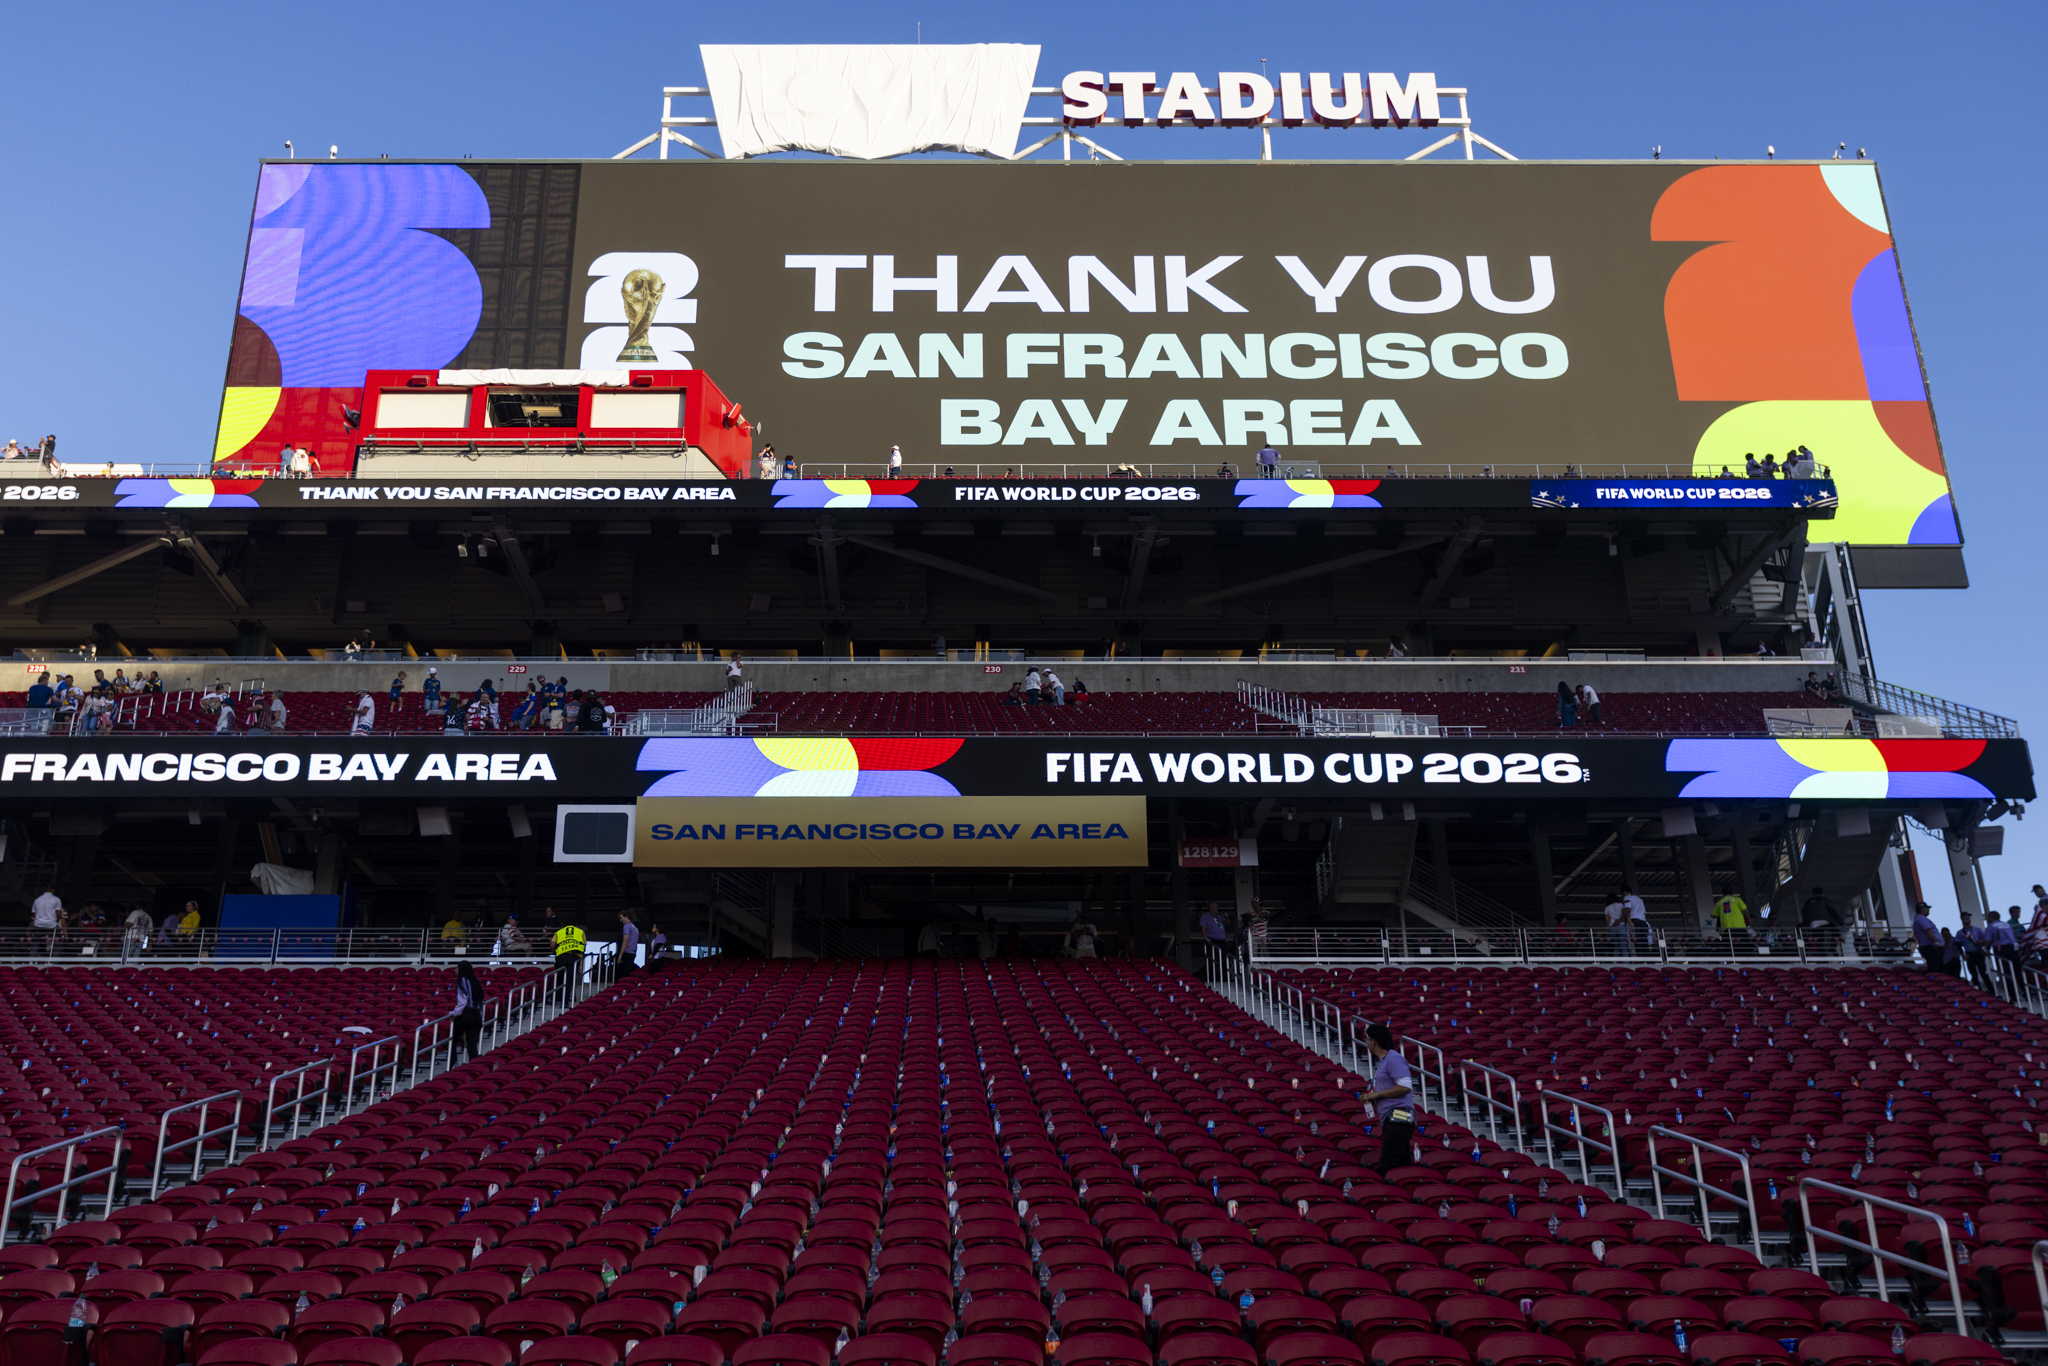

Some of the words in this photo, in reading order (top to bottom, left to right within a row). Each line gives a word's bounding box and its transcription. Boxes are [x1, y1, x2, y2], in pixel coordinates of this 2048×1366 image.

[1061, 70, 1441, 127] STADIUM
[784, 254, 1249, 313] THANK
[1275, 254, 1556, 315] YOU
[781, 332, 984, 379] SAN
[1006, 332, 1569, 380] FRANCISCO
[940, 398, 1128, 446] BAY
[1149, 399, 1423, 446] AREA
[3, 485, 77, 500] 2026
[298, 486, 380, 500] THANK
[382, 486, 432, 500] YOU
[433, 486, 484, 500] SAN
[485, 486, 621, 501] FRANCISCO
[623, 487, 670, 500] BAY
[671, 487, 737, 500] AREA
[955, 486, 999, 501] FIFA
[1002, 486, 1077, 501] WORLD
[1080, 486, 1122, 501] CUP
[1125, 486, 1197, 501] 2026
[1595, 488, 1629, 499] FIFA
[1630, 488, 1685, 499] WORLD
[1686, 488, 1717, 499] CUP
[1718, 488, 1772, 499] 2026
[28, 665, 45, 673] 228
[1, 753, 301, 782] FRANCISCO
[307, 753, 410, 781] BAY
[414, 753, 558, 781] AREA
[1046, 752, 1144, 783] FIFA
[1149, 752, 1315, 783] WORLD
[1323, 752, 1414, 784] CUP
[1422, 752, 1583, 784] 2026
[650, 823, 726, 841] SAN
[734, 823, 945, 841] FRANCISCO
[952, 823, 1022, 840] BAY
[1029, 823, 1130, 840] AREA
[1183, 846, 1210, 858] 128
[1212, 846, 1239, 858] 129
